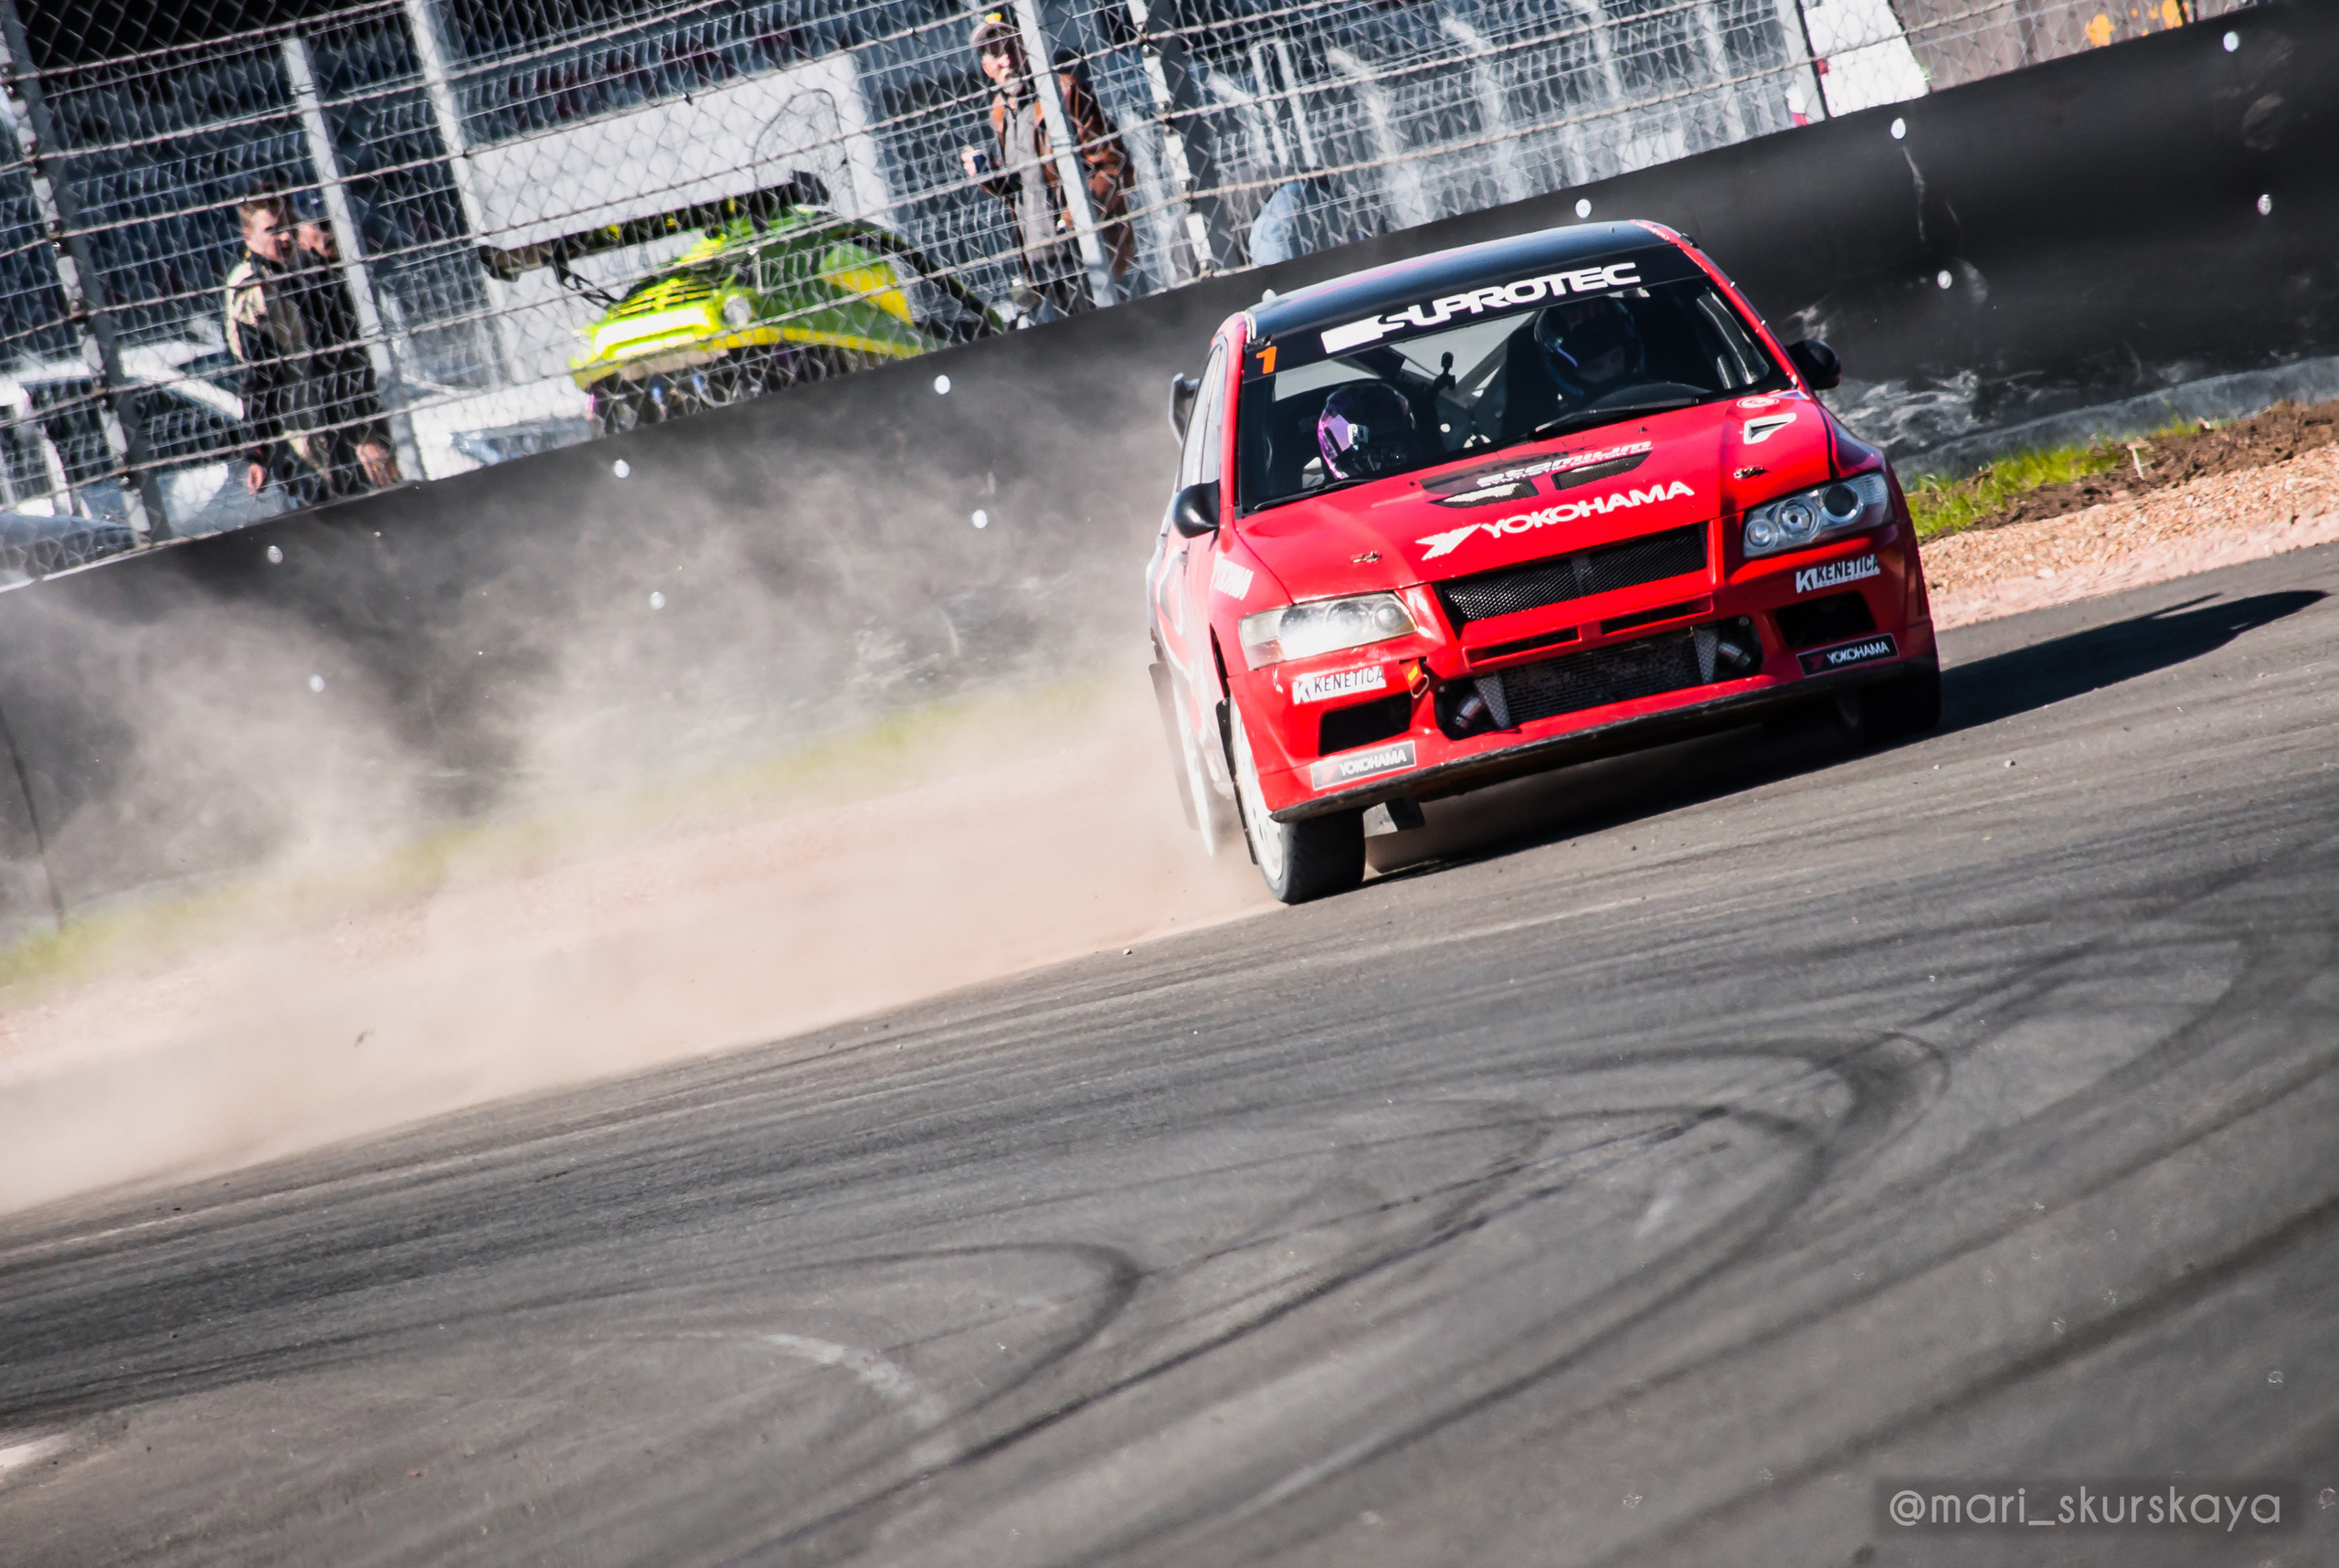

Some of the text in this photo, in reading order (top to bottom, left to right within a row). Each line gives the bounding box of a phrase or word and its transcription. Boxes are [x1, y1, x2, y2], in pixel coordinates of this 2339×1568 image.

[1378, 262, 1642, 334] SUPROTEC
[1255, 346, 1276, 374] 1
[1481, 482, 1695, 538] YOKOHAMA
[1816, 554, 1879, 582] KENETICA
[1827, 641, 1889, 664] YOKOHAMA
[1314, 666, 1384, 694] KENETICA
[1339, 748, 1408, 776] YOKOHAMA
